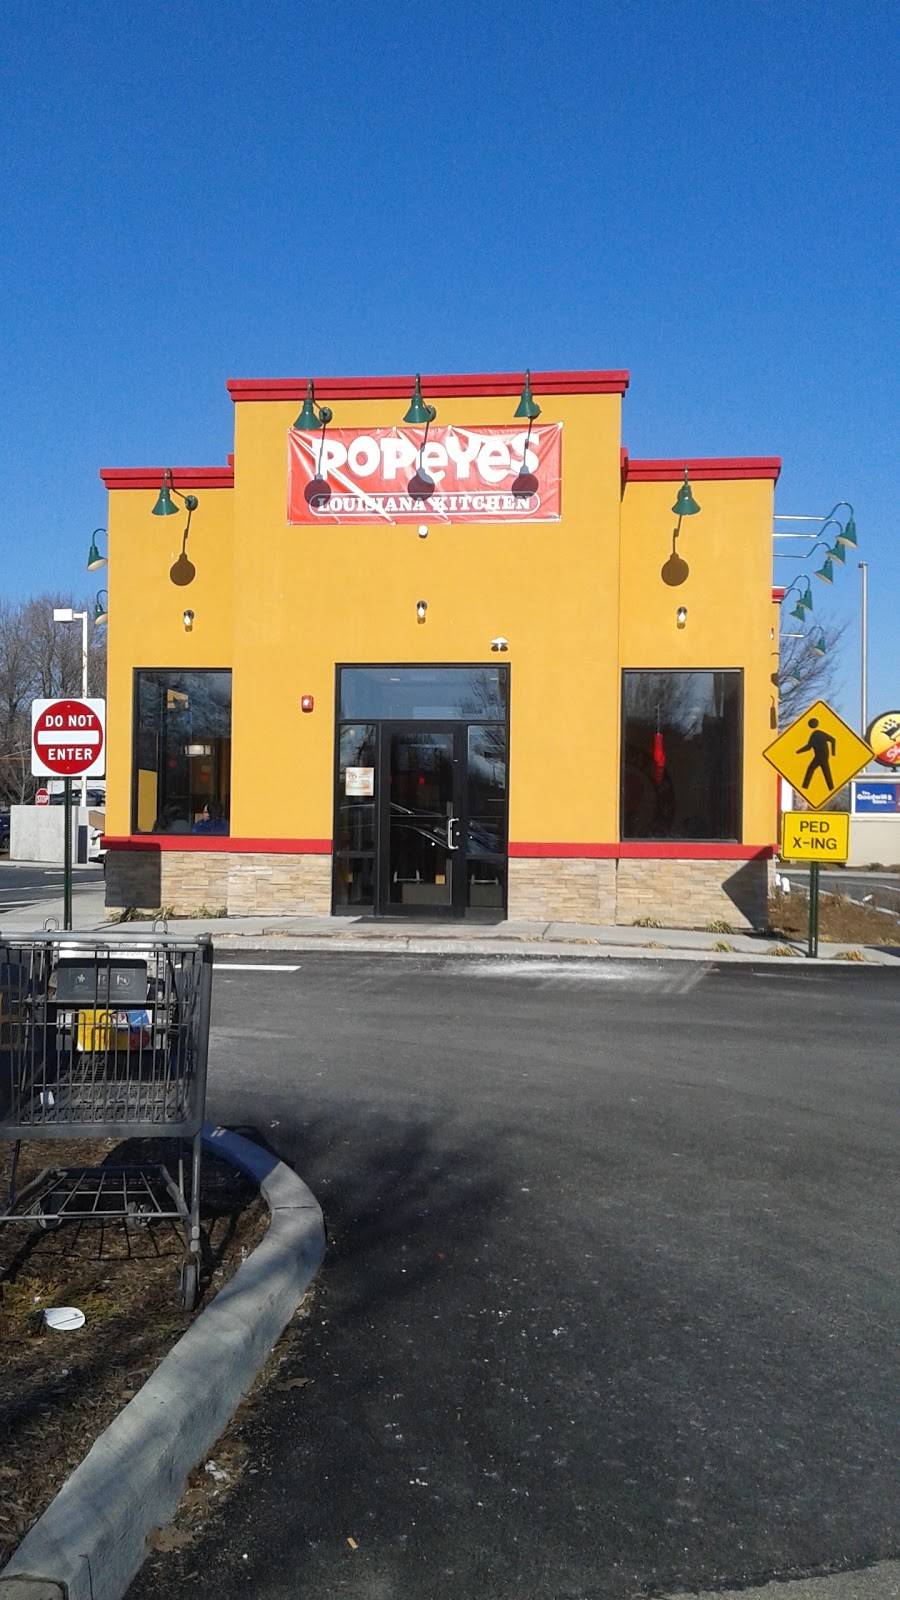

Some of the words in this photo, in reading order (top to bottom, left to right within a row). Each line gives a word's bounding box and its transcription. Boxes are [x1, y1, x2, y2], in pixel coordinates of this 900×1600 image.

[318, 497, 427, 513] LOUISIANA
[432, 494, 531, 512] KITCHEN
[45, 715, 63, 728] DO
[68, 714, 94, 727] NOT
[48, 748, 93, 761] ENTER
[800, 821, 830, 833] PED
[793, 837, 838, 850] X-ING
